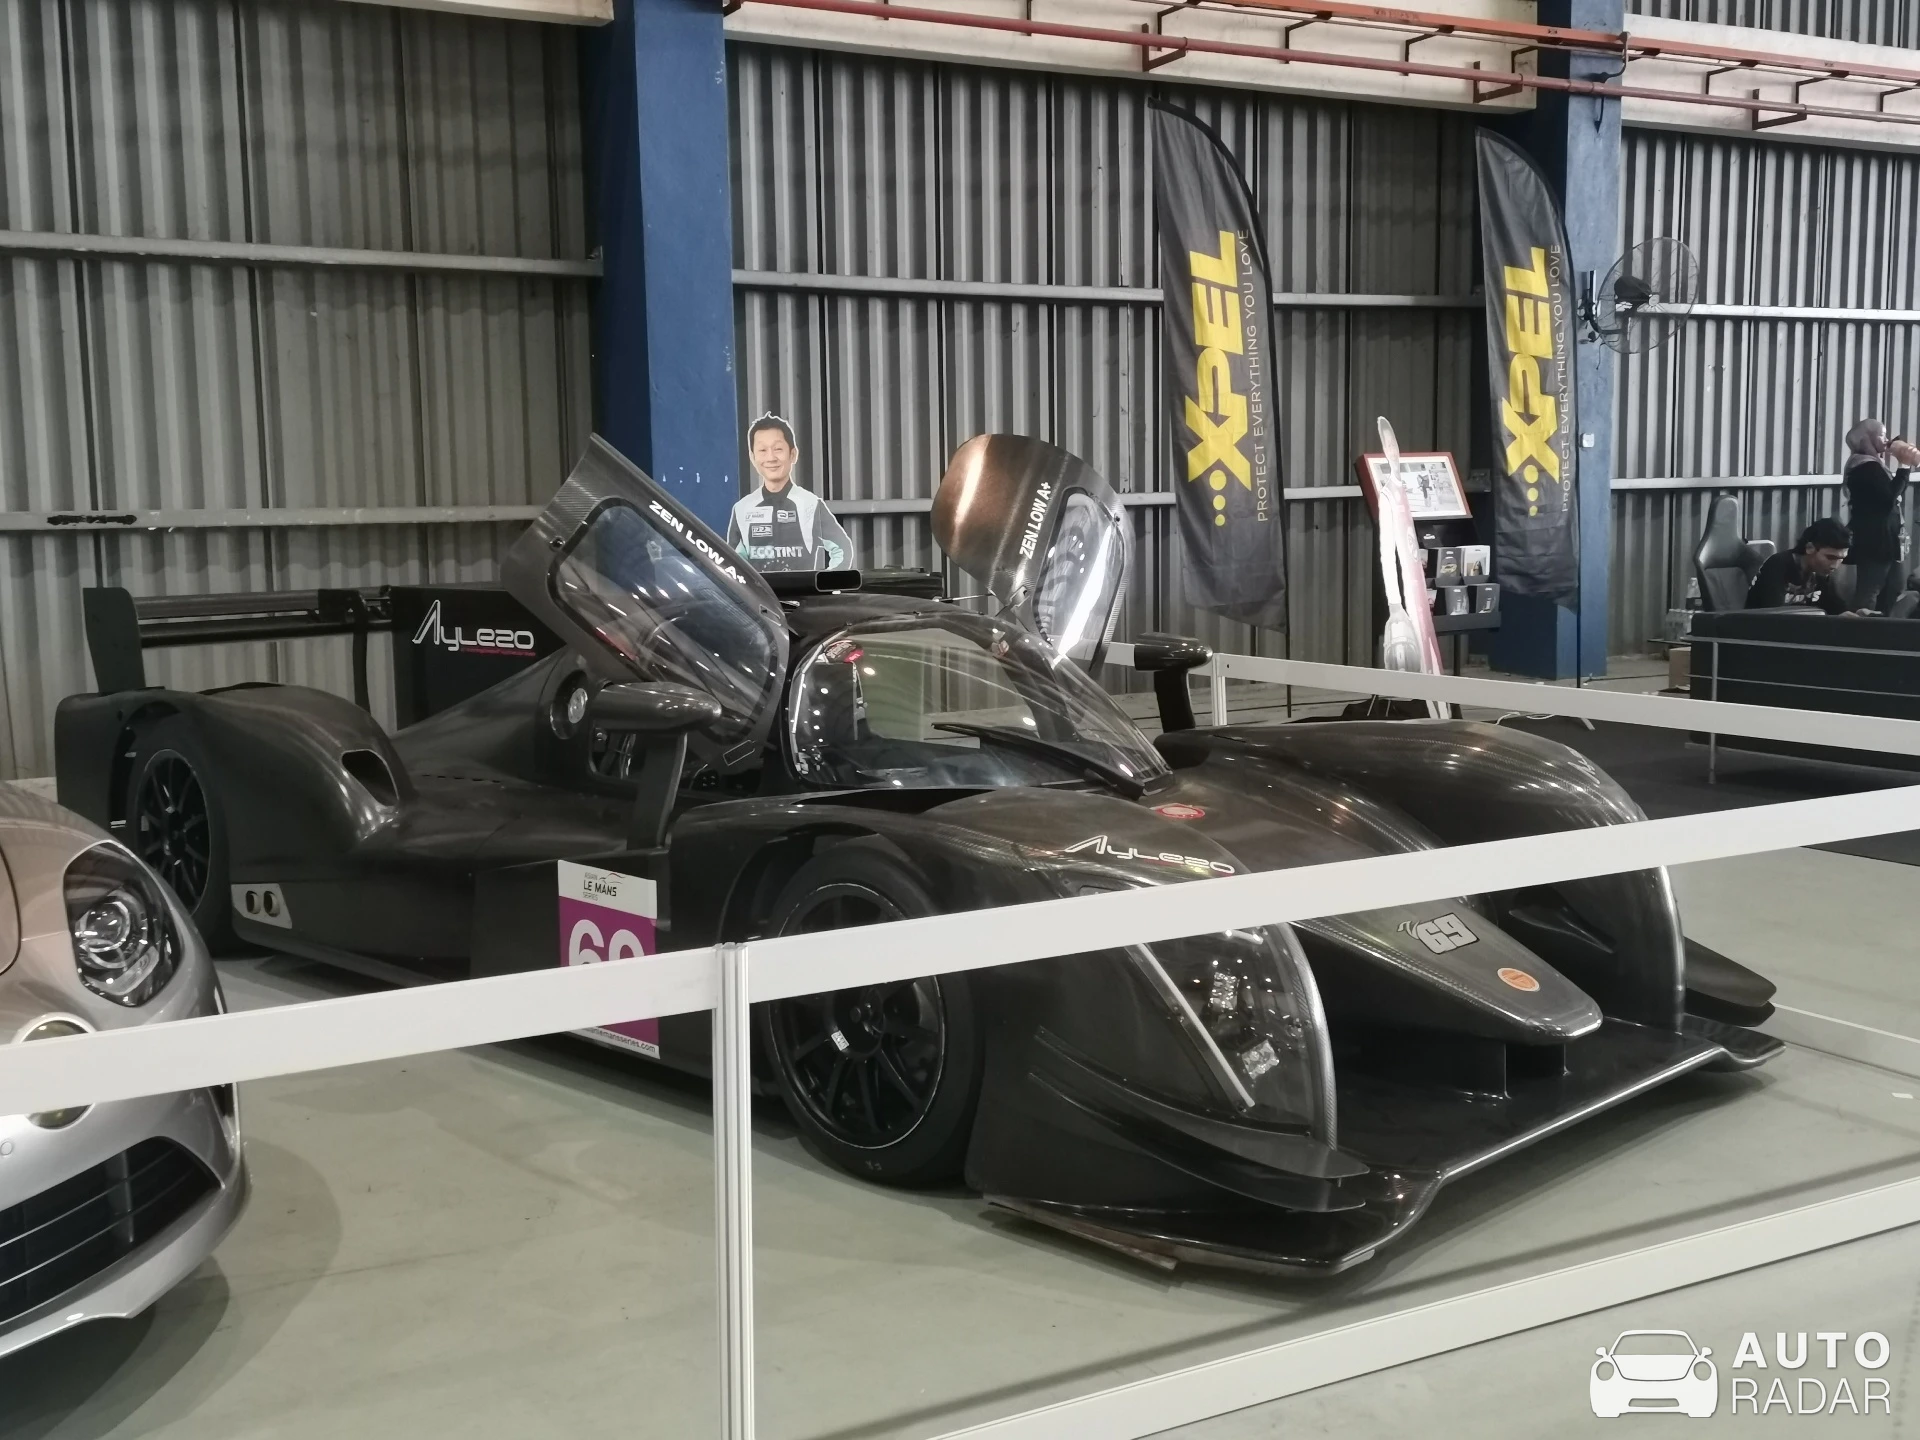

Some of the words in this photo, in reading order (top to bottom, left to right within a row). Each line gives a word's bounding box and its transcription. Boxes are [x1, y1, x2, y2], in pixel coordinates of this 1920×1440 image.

[1237, 229, 1253, 275] LOVE
[1550, 244, 1561, 287] LOVE
[1243, 282, 1256, 319] YOU
[1552, 293, 1563, 327] YOU
[1185, 230, 1252, 492] XPEL
[1246, 325, 1264, 437] EVERYTHING
[1502, 246, 1559, 485] XPEL
[1555, 332, 1570, 434] EVERYTHING
[1036, 481, 1052, 500] A+
[1254, 444, 1269, 522] PROTECT
[649, 500, 684, 533] ZEN
[685, 529, 725, 565] LOW
[1027, 497, 1048, 531] LOW
[749, 546, 804, 559] ECOTINT
[1019, 529, 1040, 559] ZEN
[583, 880, 593, 891] LE
[594, 882, 618, 897] MANS
[1416, 912, 1480, 955] 69
